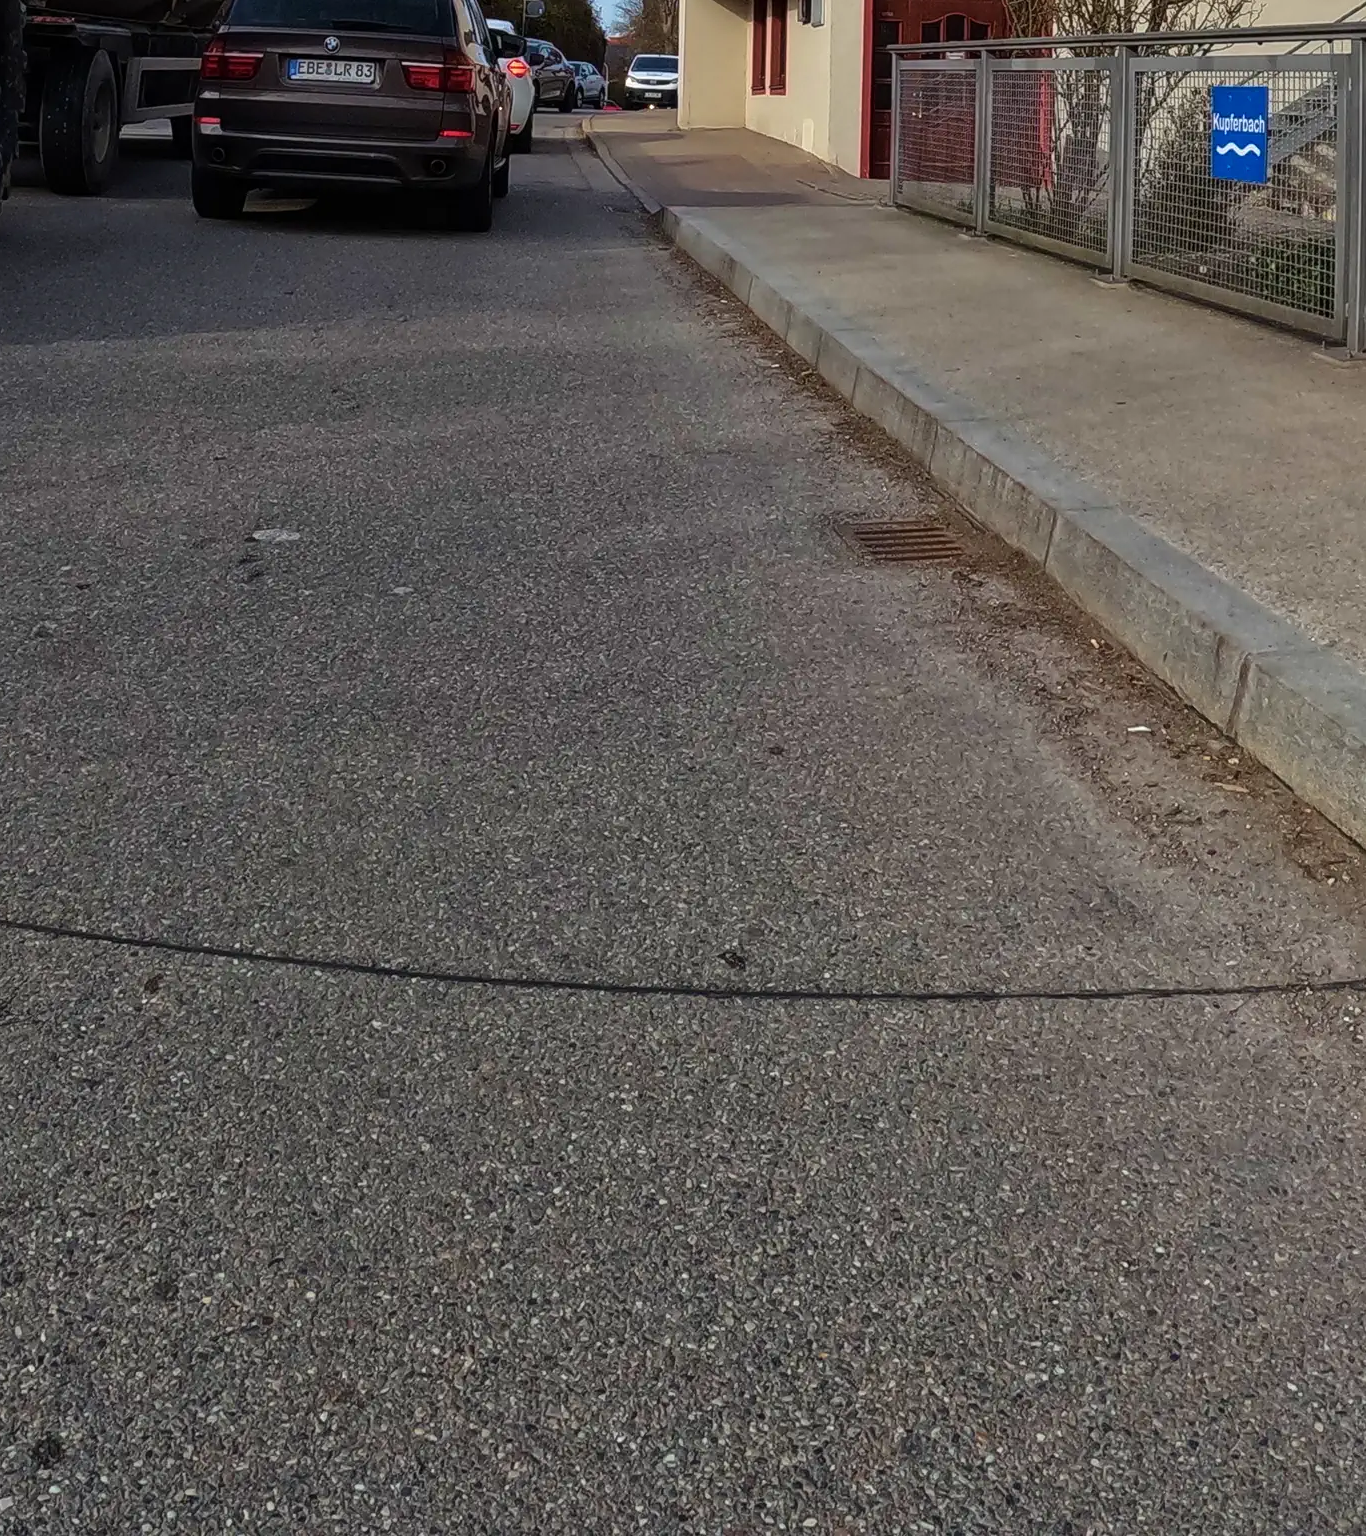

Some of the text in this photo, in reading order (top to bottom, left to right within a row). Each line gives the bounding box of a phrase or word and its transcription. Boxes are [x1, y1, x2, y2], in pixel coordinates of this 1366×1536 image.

[297, 61, 373, 78] EBE LR 83
[1212, 112, 1265, 135] Kupferbach
